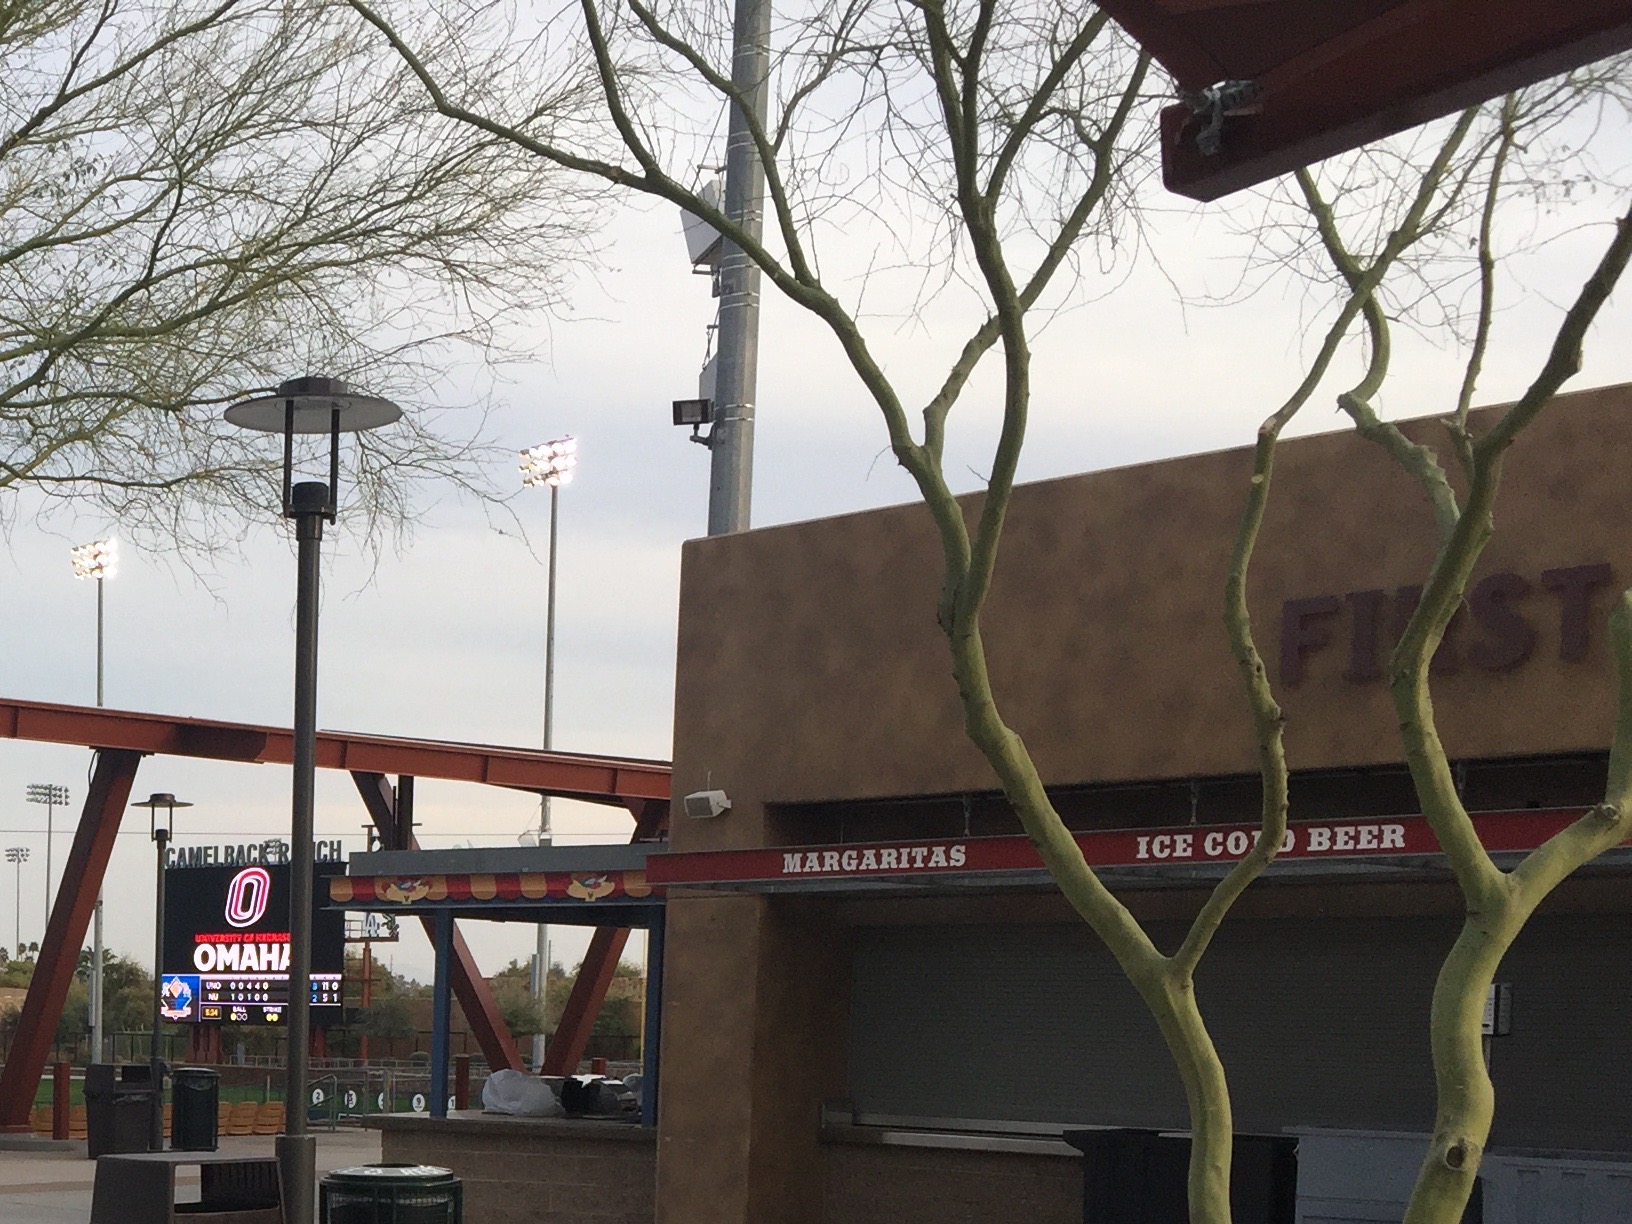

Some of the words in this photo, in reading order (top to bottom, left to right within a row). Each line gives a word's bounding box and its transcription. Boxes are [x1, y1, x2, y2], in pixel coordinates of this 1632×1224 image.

[166, 843, 269, 869] CAMELBACK
[278, 839, 342, 865] RCH
[1136, 834, 1194, 859] ICE
[1204, 829, 1296, 856] COD
[1307, 824, 1405, 852] BEER
[782, 844, 966, 874] MARGARITAS
